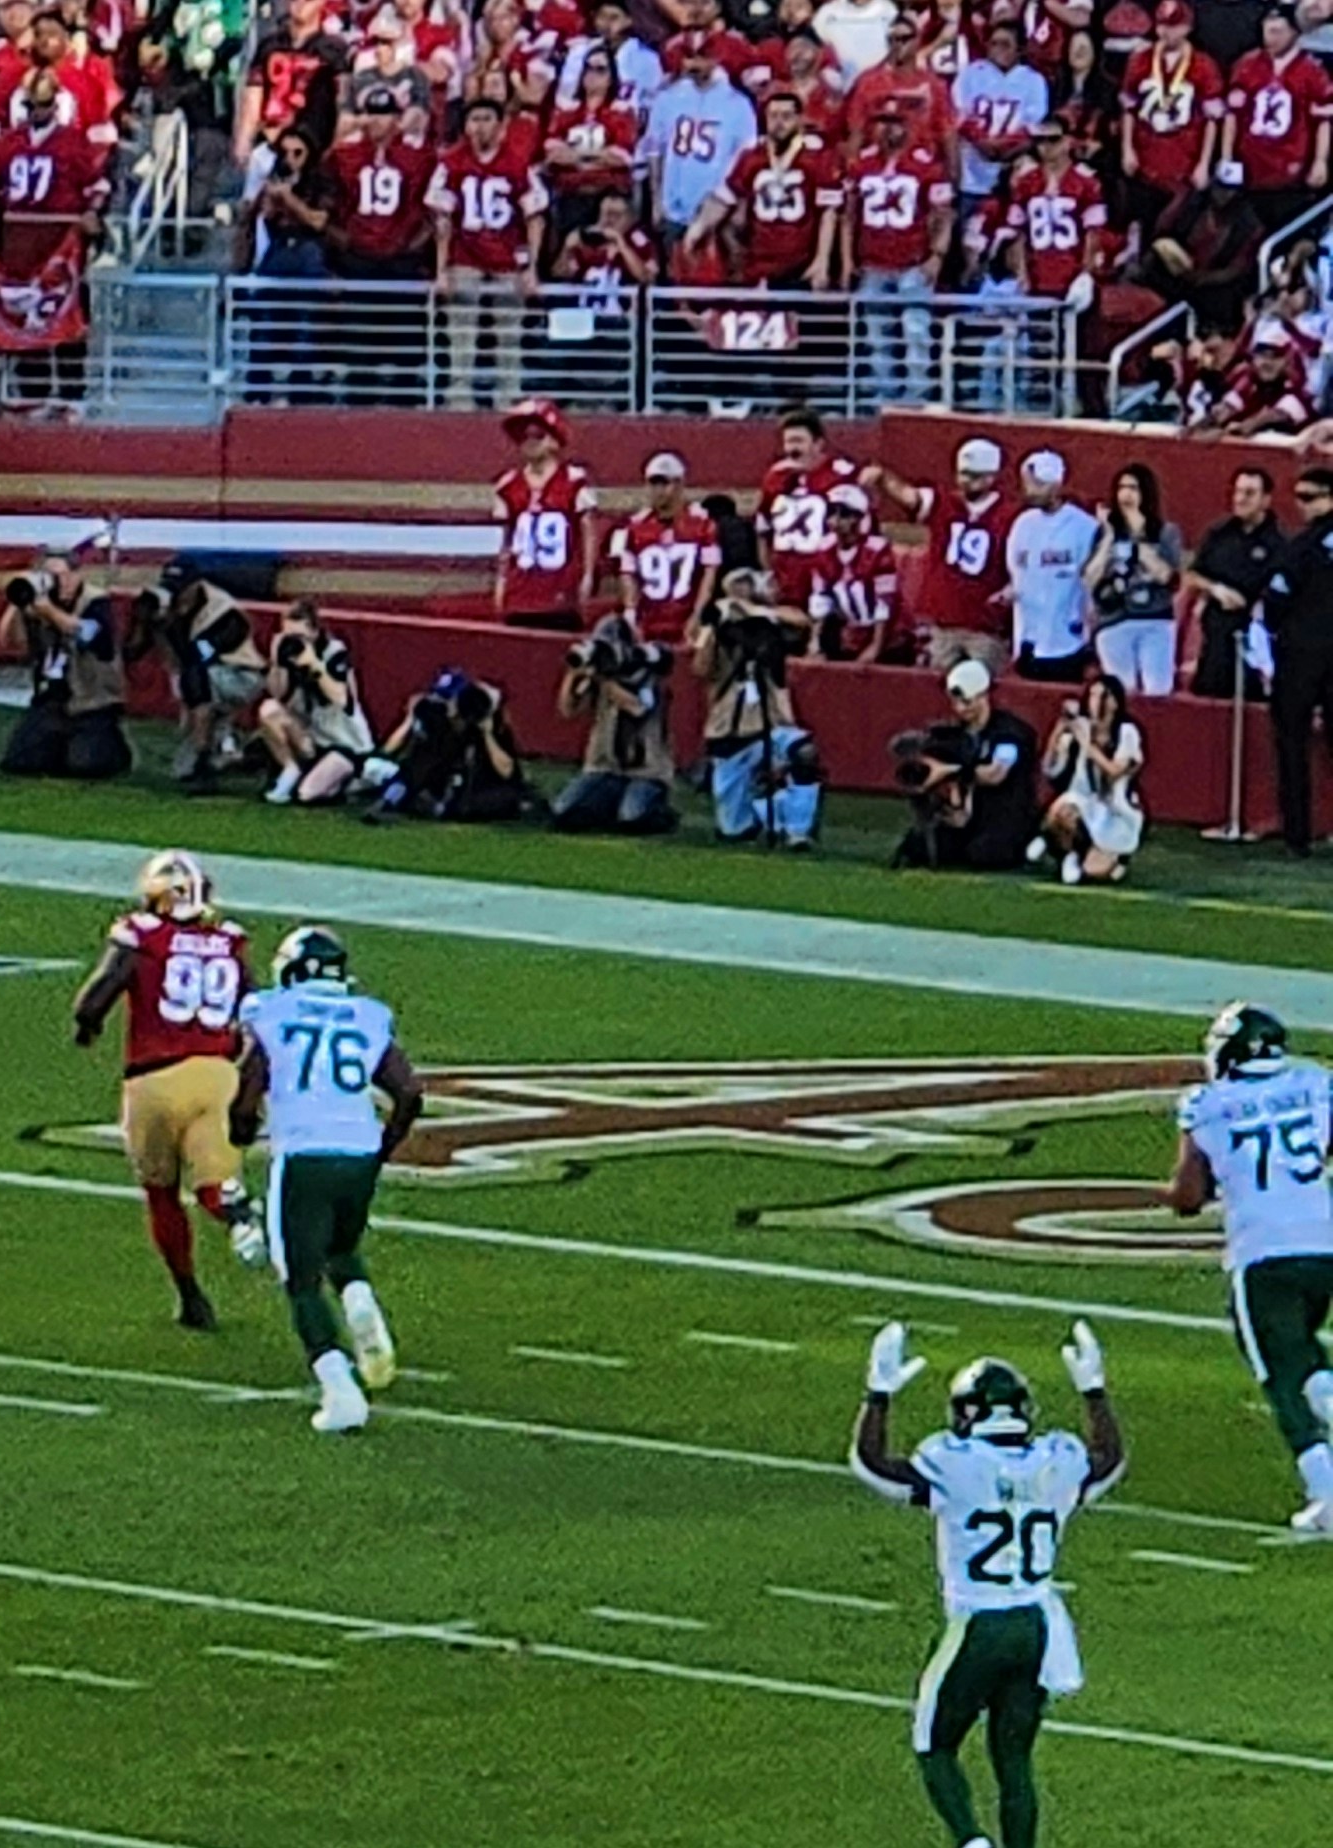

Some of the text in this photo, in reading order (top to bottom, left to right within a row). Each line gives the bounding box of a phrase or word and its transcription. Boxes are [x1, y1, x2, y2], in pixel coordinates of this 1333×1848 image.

[674, 115, 720, 162] 85
[1250, 86, 1292, 137] 13
[9, 156, 53, 200] 97
[359, 165, 402, 215] 19
[461, 176, 514, 231] 16
[859, 174, 920, 228] 23
[1027, 196, 1079, 249] 85
[721, 311, 786, 349] 124
[512, 511, 568, 570] 49
[771, 495, 827, 553] 23
[948, 522, 990, 575] 19
[639, 544, 701, 600] 97
[833, 581, 872, 626] 11
[158, 954, 240, 1028] 99
[281, 1021, 370, 1094] 76
[1229, 1113, 1323, 1191] 75
[964, 1507, 1059, 1586] 20
